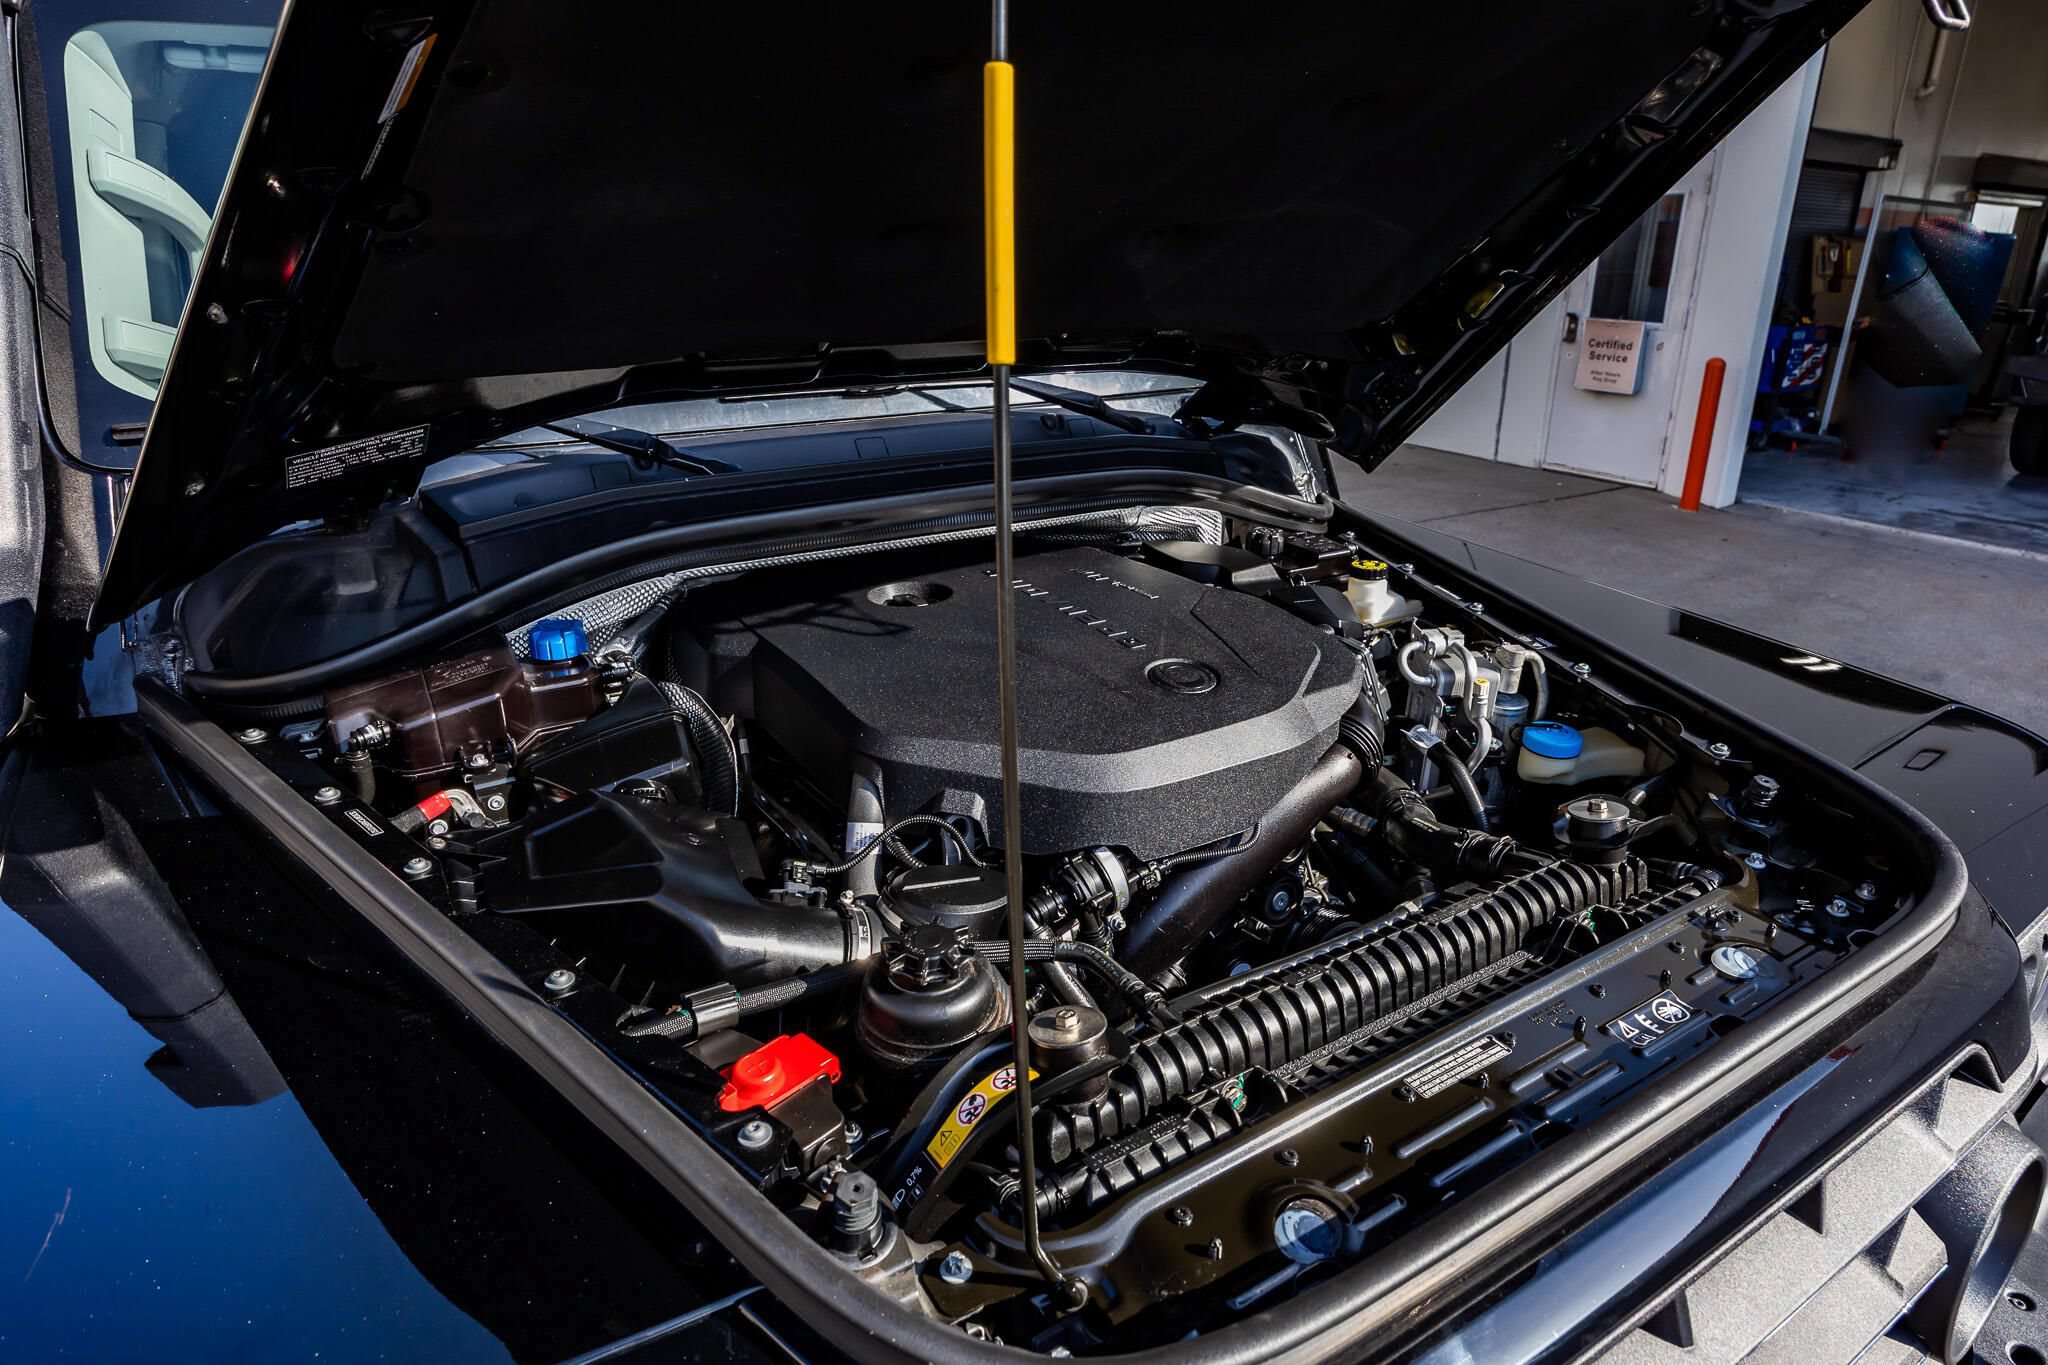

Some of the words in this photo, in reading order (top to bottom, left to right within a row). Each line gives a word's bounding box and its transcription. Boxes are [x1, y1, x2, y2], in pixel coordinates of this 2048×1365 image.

[1588, 339, 1634, 351] Certified
[1588, 351, 1628, 363] Service
[292, 454, 320, 464] VEHICLE
[320, 447, 351, 457] EMISSION
[351, 440, 381, 450] CONTROL
[381, 429, 424, 442] INFORMATION
